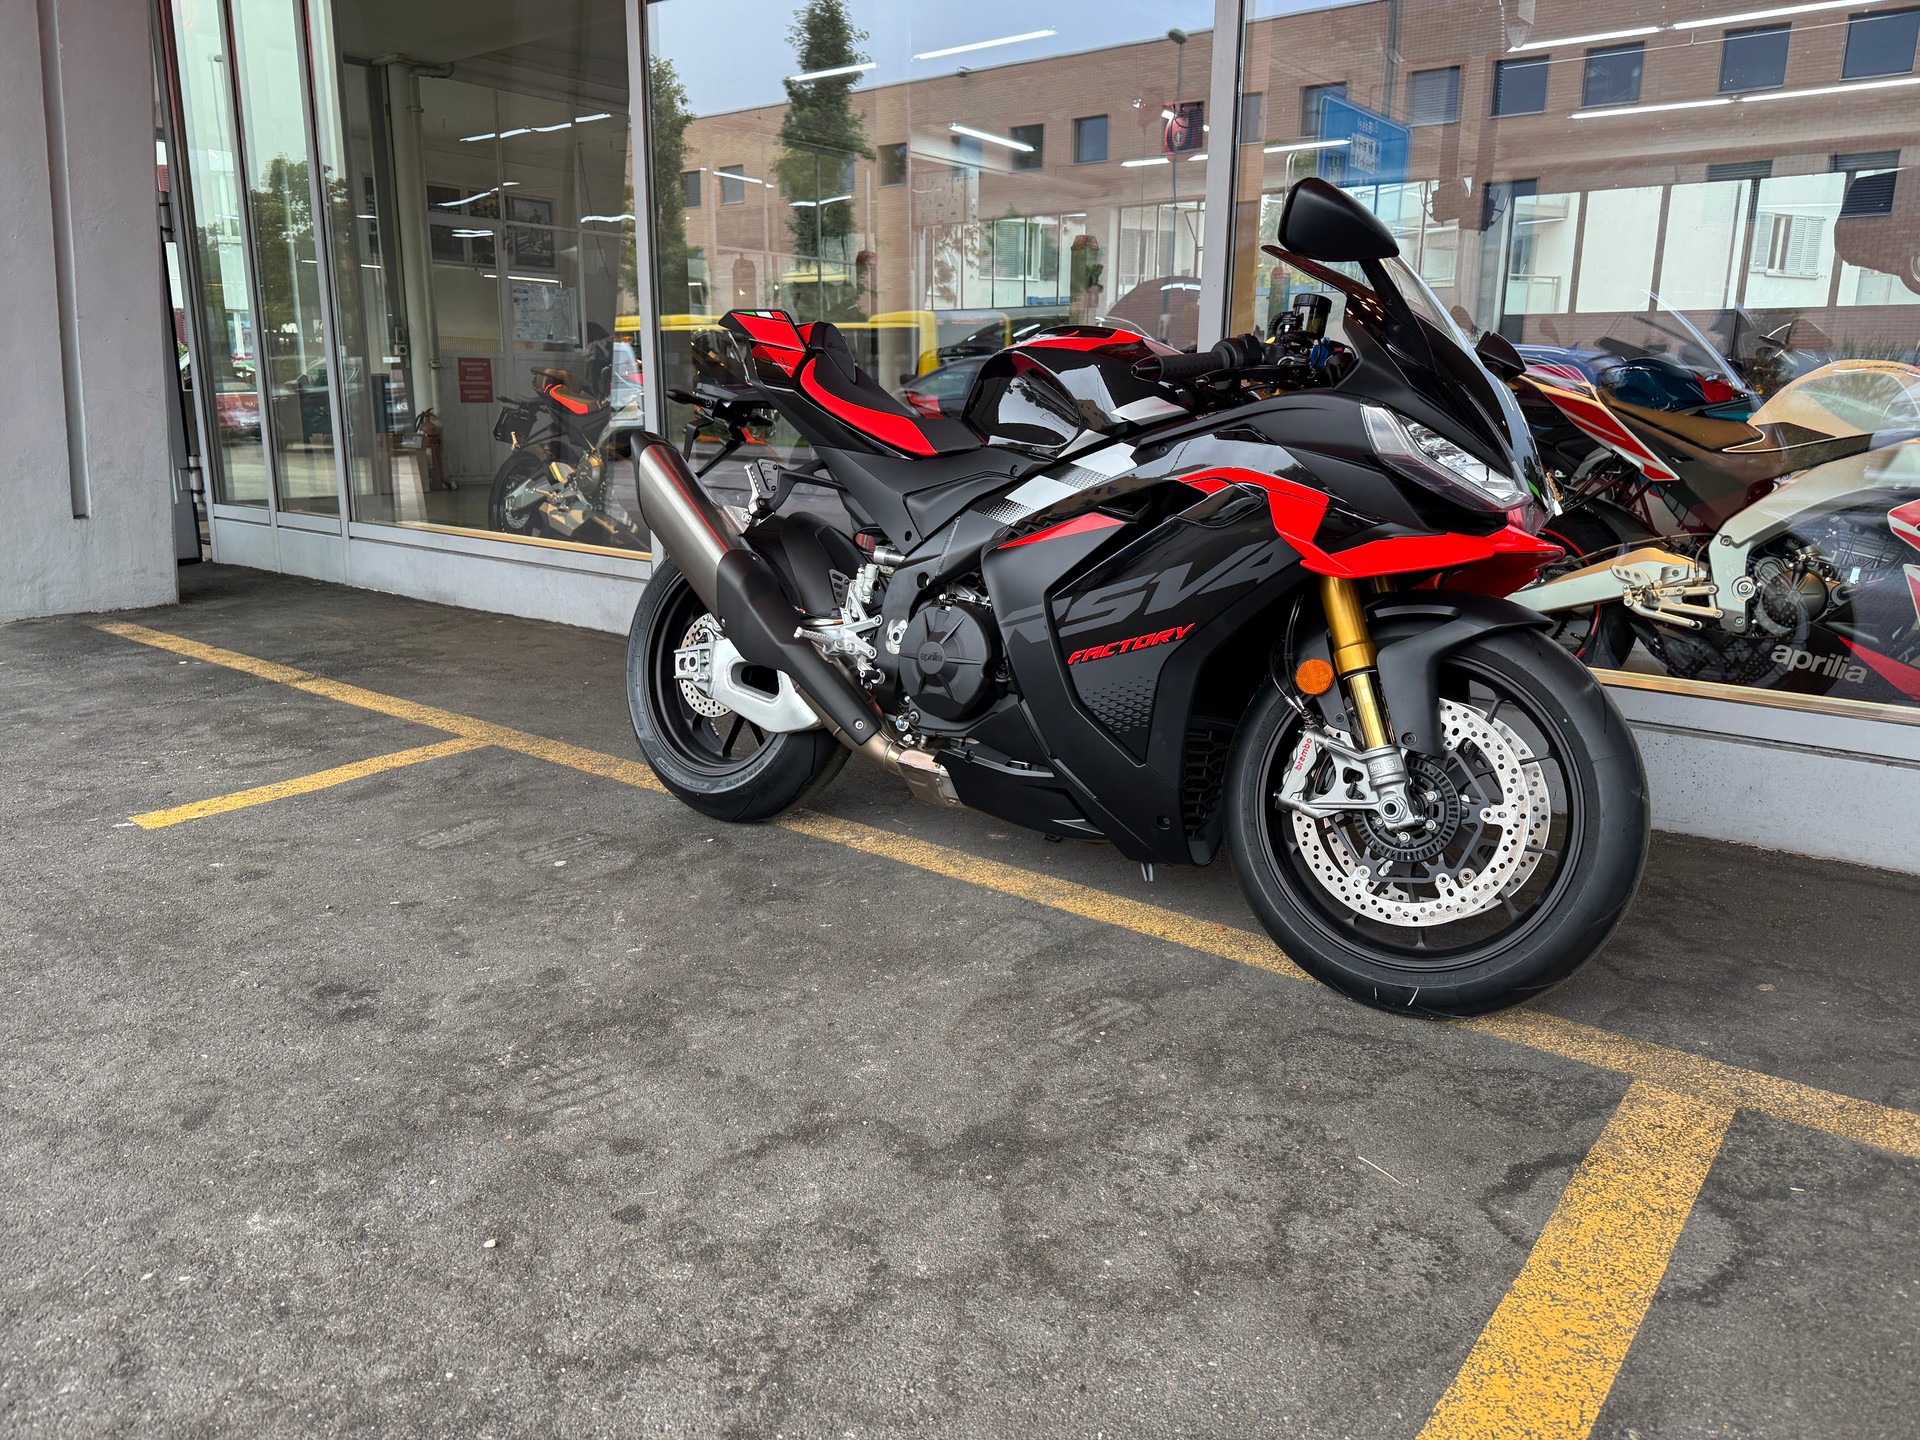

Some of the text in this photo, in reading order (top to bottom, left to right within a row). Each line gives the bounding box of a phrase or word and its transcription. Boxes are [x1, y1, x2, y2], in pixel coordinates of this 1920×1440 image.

[1067, 622, 1196, 666] FACTORY
[1770, 644, 1868, 684] aprilia
[1295, 737, 1313, 771] brembo
